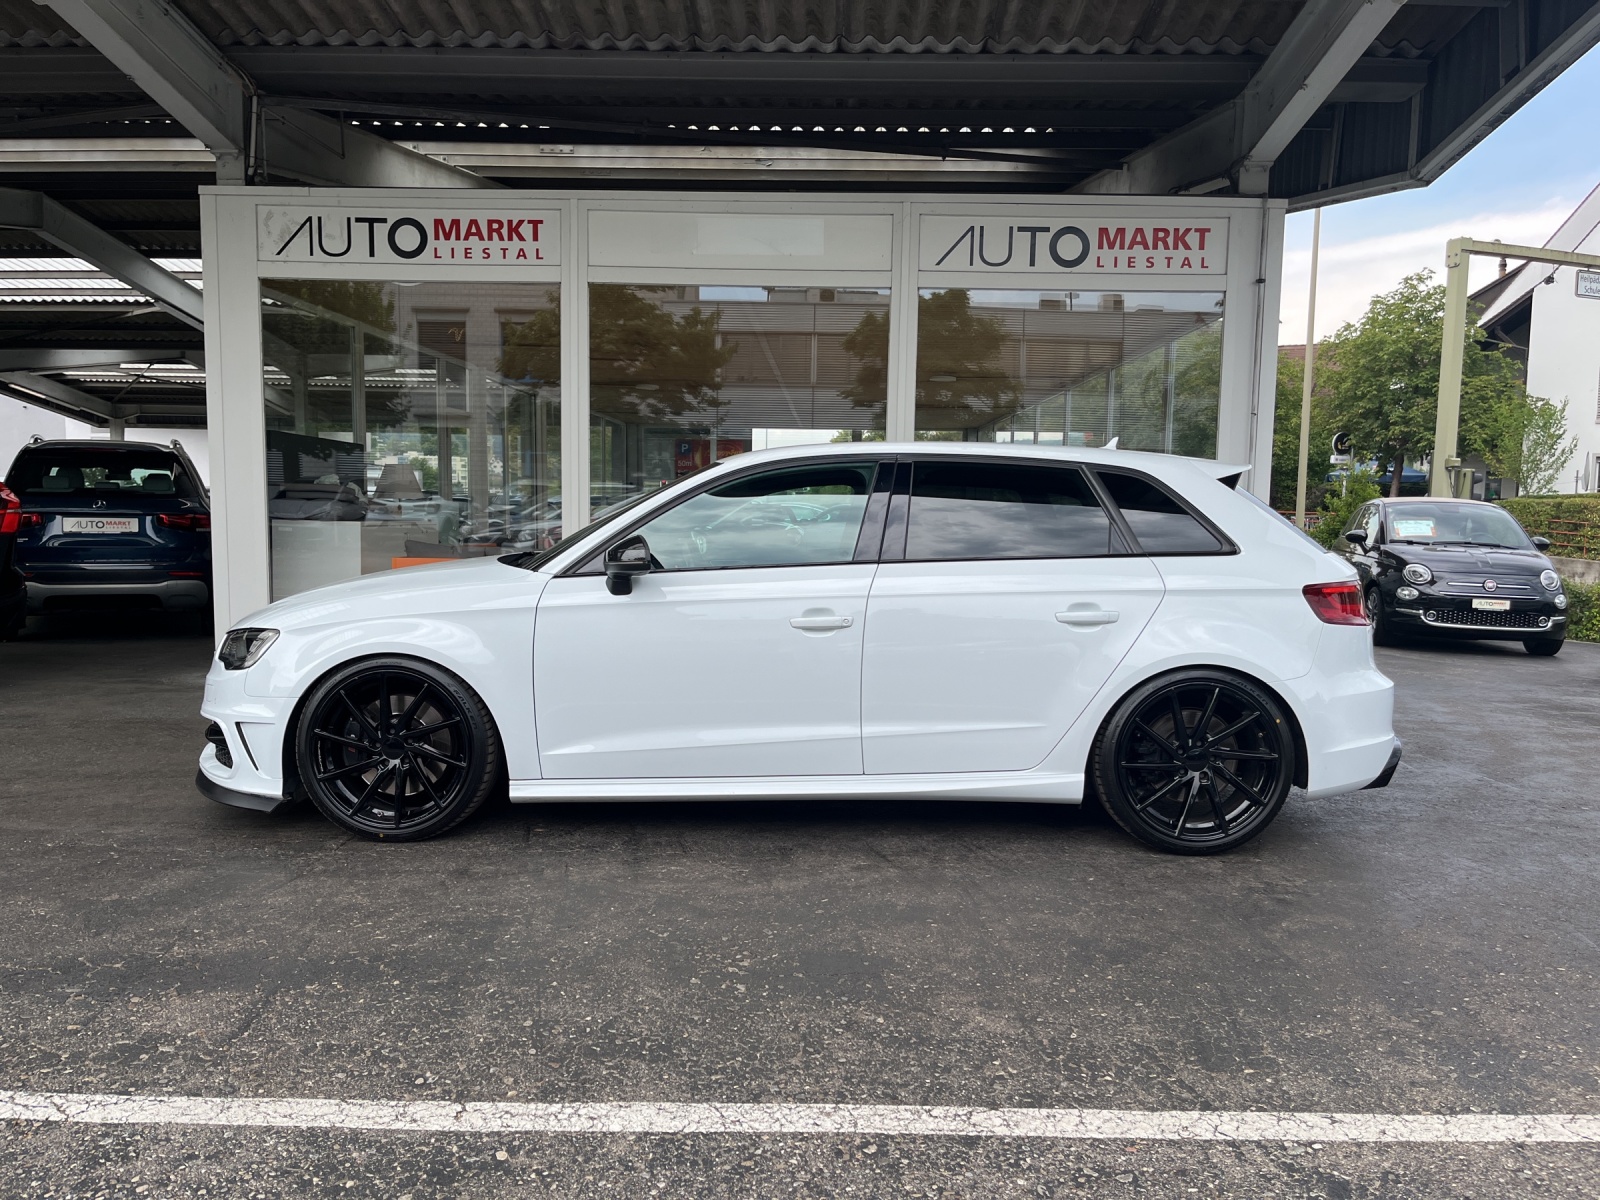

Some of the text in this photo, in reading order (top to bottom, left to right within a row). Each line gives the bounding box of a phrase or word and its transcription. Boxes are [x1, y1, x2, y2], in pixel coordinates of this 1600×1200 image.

[275, 216, 544, 259] AUTO MARKT
[935, 225, 1211, 268] AUTO MARKT
[433, 247, 544, 260] LIESTAL
[1096, 255, 1209, 269] LIESTAL
[681, 443, 689, 453] P
[71, 520, 105, 529] AUTO
